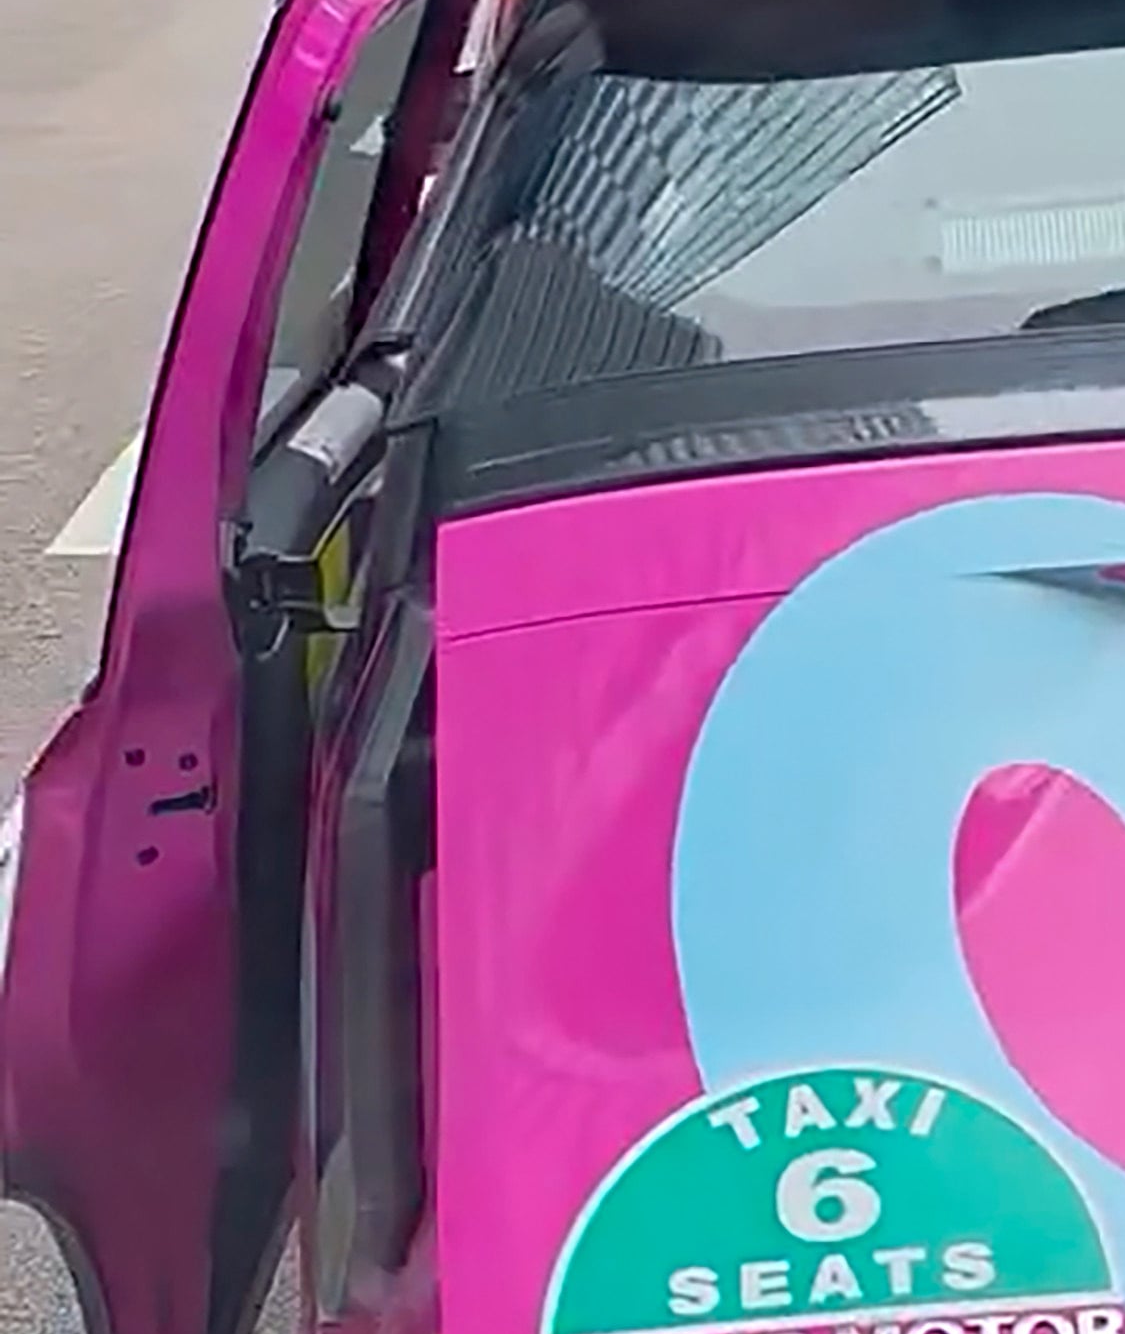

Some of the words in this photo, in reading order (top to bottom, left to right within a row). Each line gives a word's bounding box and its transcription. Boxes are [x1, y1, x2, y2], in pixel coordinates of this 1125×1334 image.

[706, 1076, 947, 1151] TAXI
[775, 1147, 882, 1243] 6
[667, 1241, 997, 1317] SEATS
